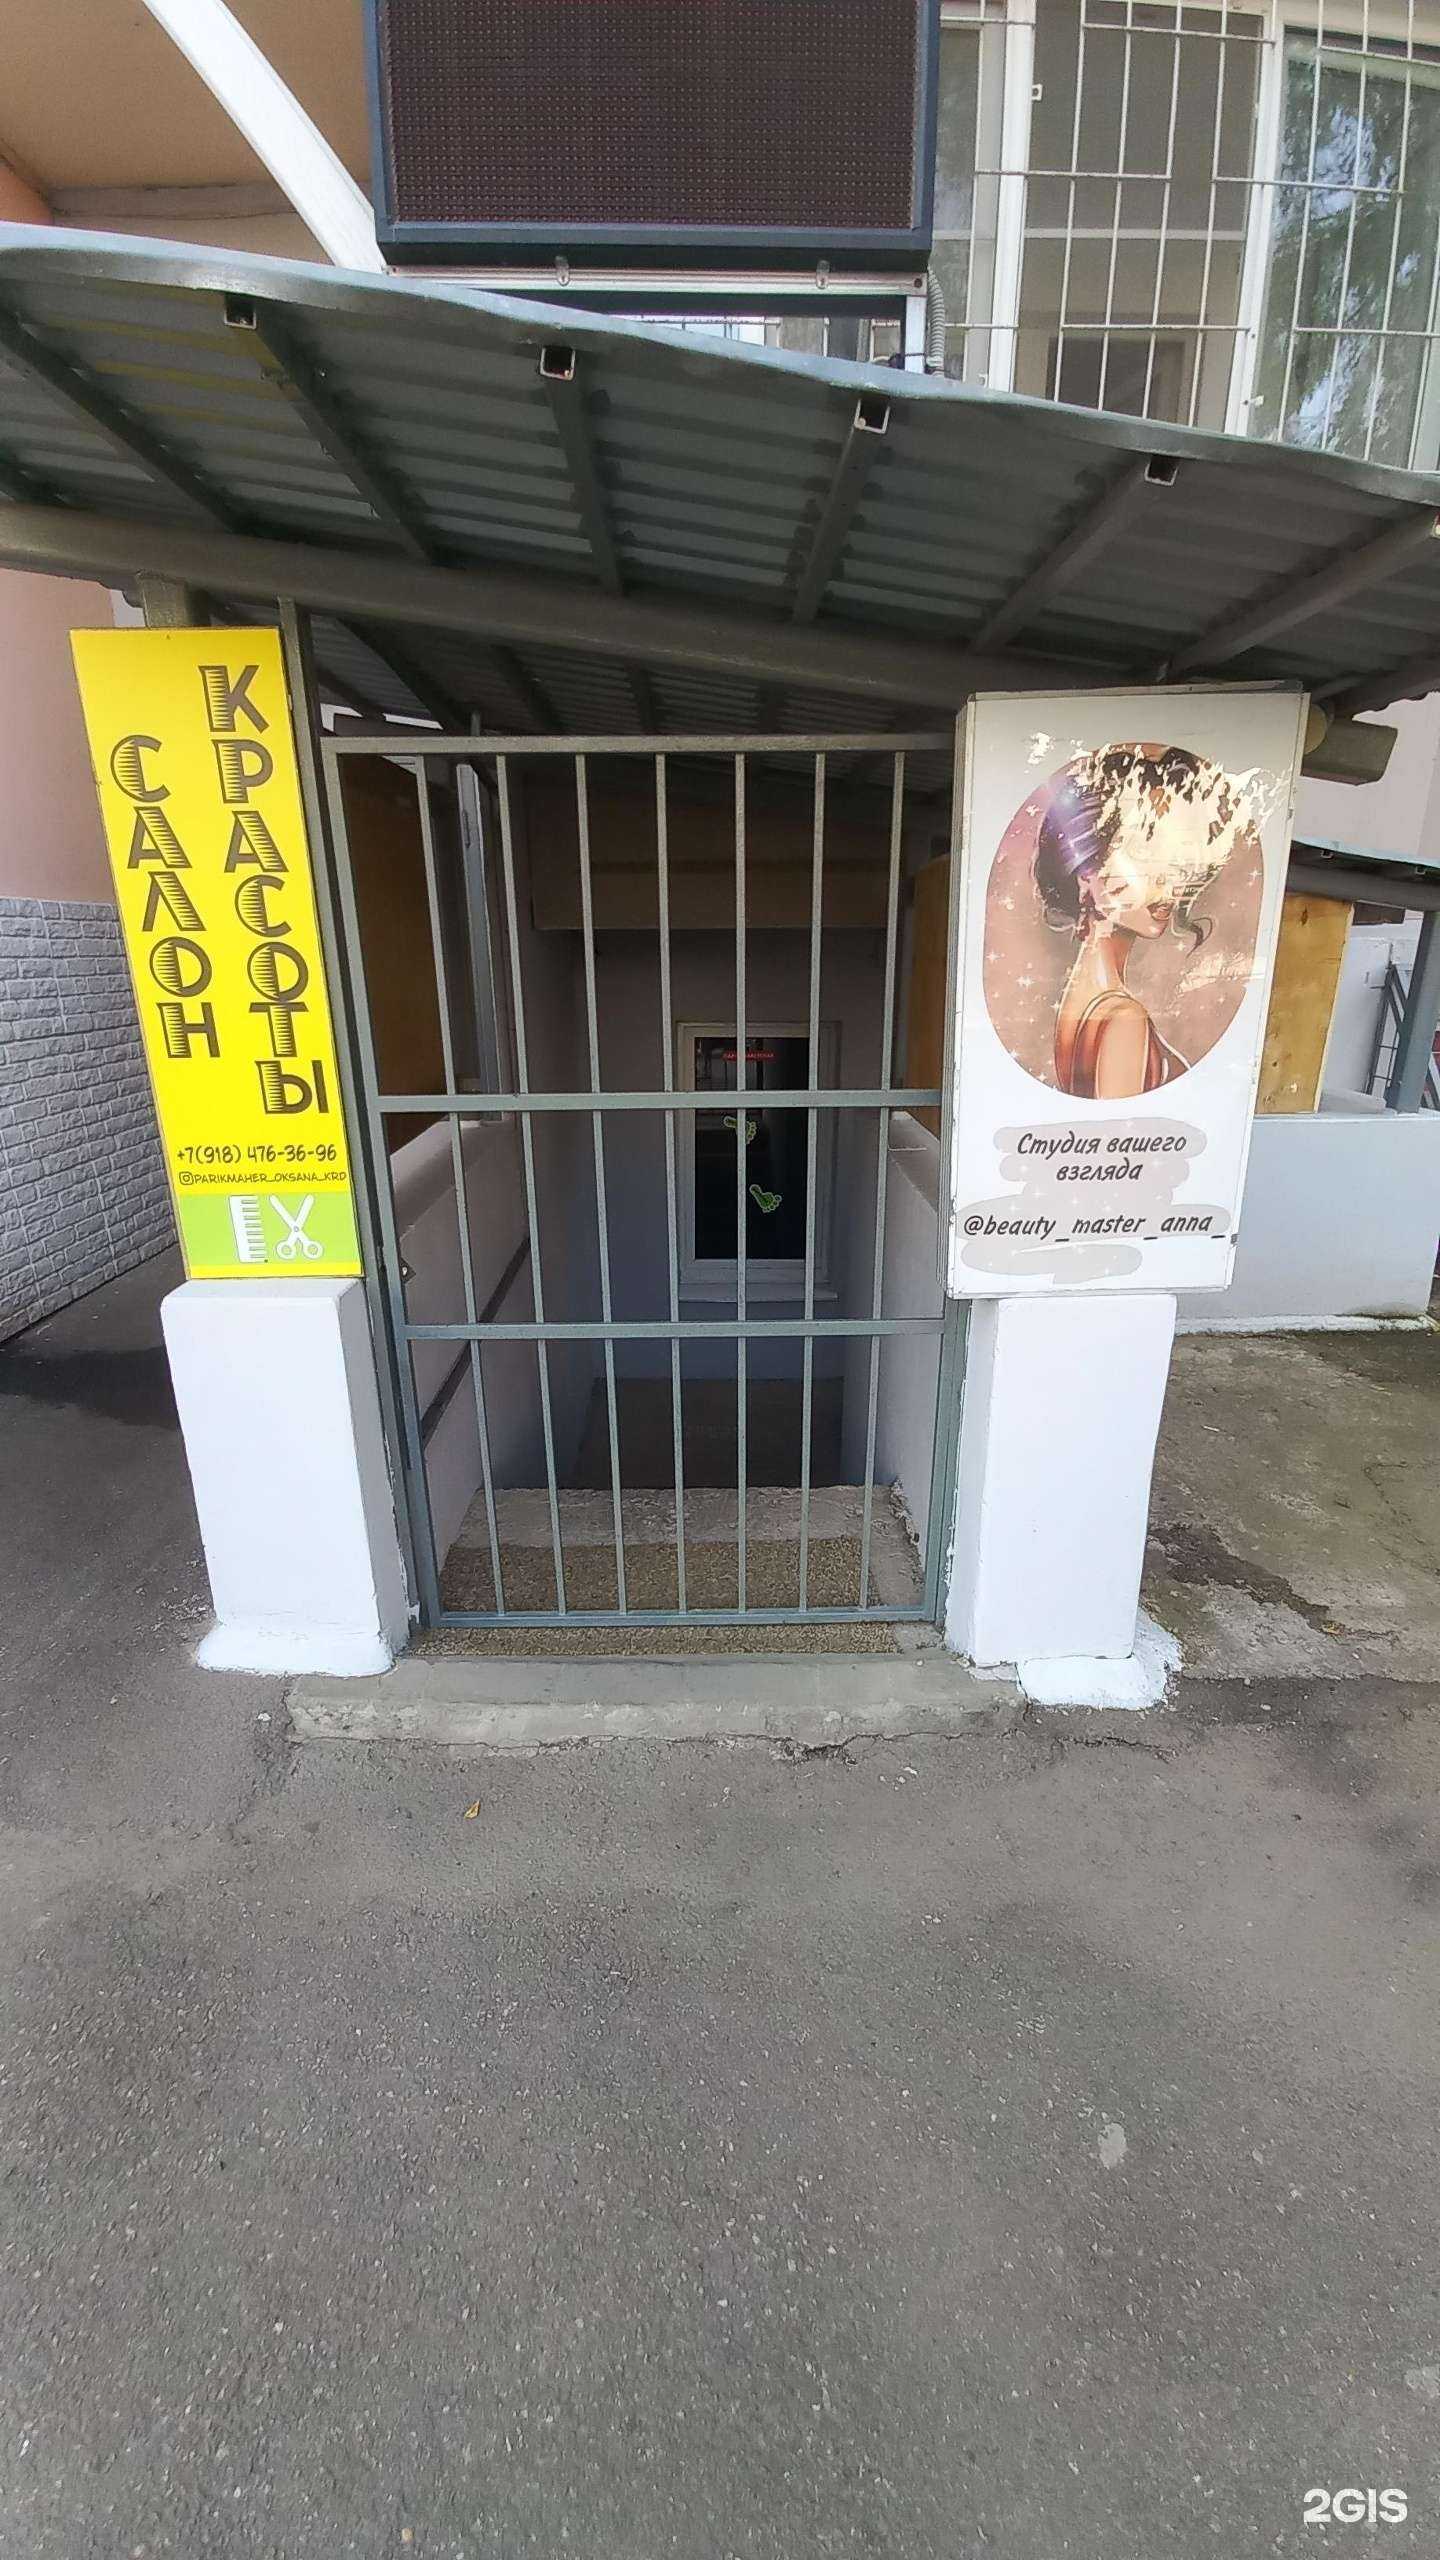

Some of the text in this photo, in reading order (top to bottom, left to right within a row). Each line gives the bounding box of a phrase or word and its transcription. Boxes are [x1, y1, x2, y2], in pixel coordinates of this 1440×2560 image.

[110, 734, 220, 1059] САЛОН
[198, 665, 328, 1115] КРАСОТЫ
[177, 1143, 337, 1165] +7(918) 476-36-96
[1017, 1131, 1187, 1160] Студия вашего
[1056, 1157, 1143, 1181] взгляда
